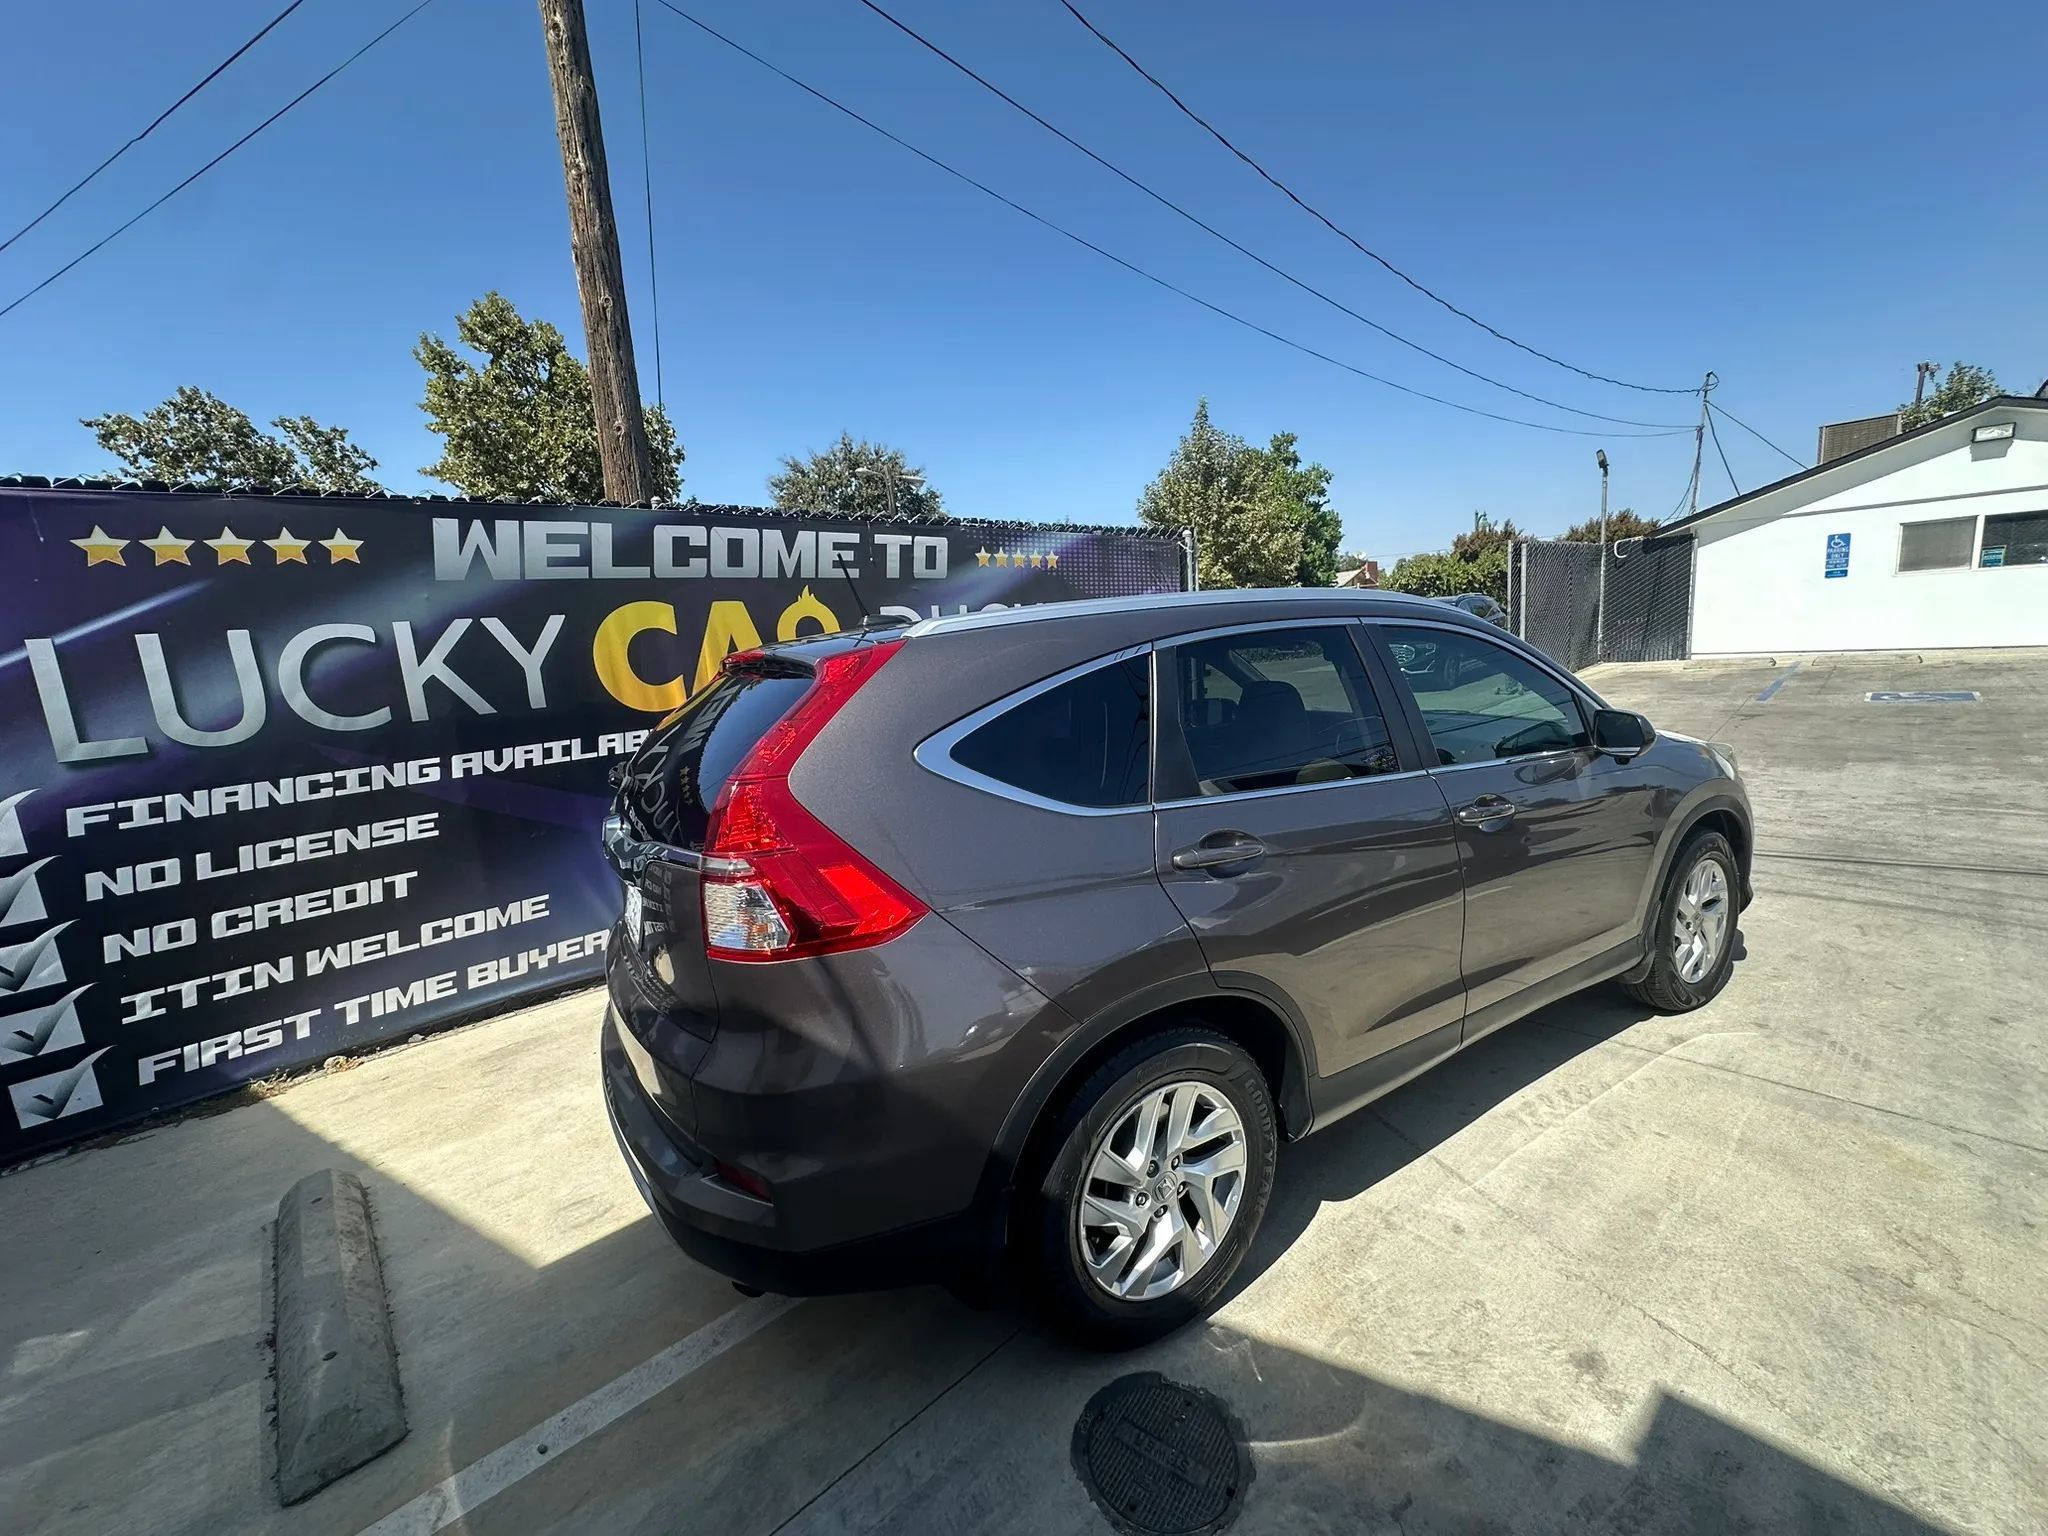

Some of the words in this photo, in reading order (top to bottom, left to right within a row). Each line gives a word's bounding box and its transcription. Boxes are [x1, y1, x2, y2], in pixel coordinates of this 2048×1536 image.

[433, 517, 860, 581] WELCOME
[873, 535, 948, 579] TO
[24, 614, 566, 763] LUCKY
[65, 760, 440, 837] FINANCING
[451, 729, 656, 778] AVAILAB
[85, 858, 180, 901] NO
[196, 813, 440, 880] LICENSE
[103, 918, 197, 964] NO
[211, 871, 418, 939] CREDIT
[120, 956, 294, 1025] ITIN
[306, 895, 550, 977] WELCOME
[138, 1009, 322, 1086] FIRST
[334, 971, 457, 1026] TIME
